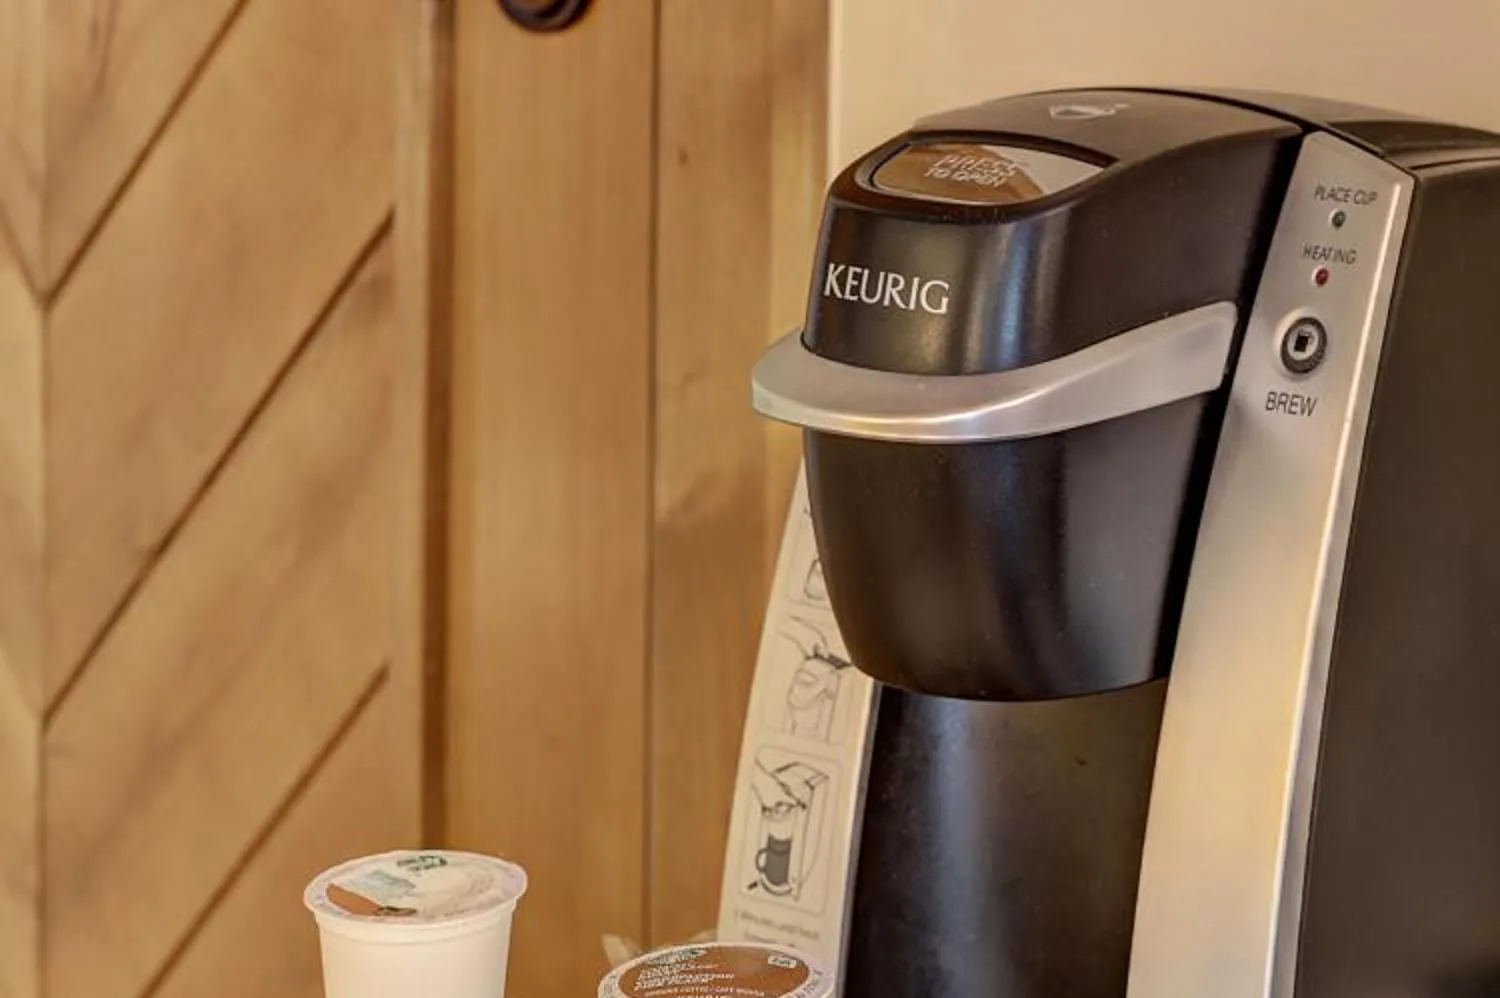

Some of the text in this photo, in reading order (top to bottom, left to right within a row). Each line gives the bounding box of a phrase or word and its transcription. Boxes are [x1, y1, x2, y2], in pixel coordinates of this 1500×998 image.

[1313, 185, 1378, 205] PLACE CUP
[1302, 244, 1357, 266] HEATING
[823, 262, 949, 314] KEURIG
[1265, 391, 1317, 417] BREW
